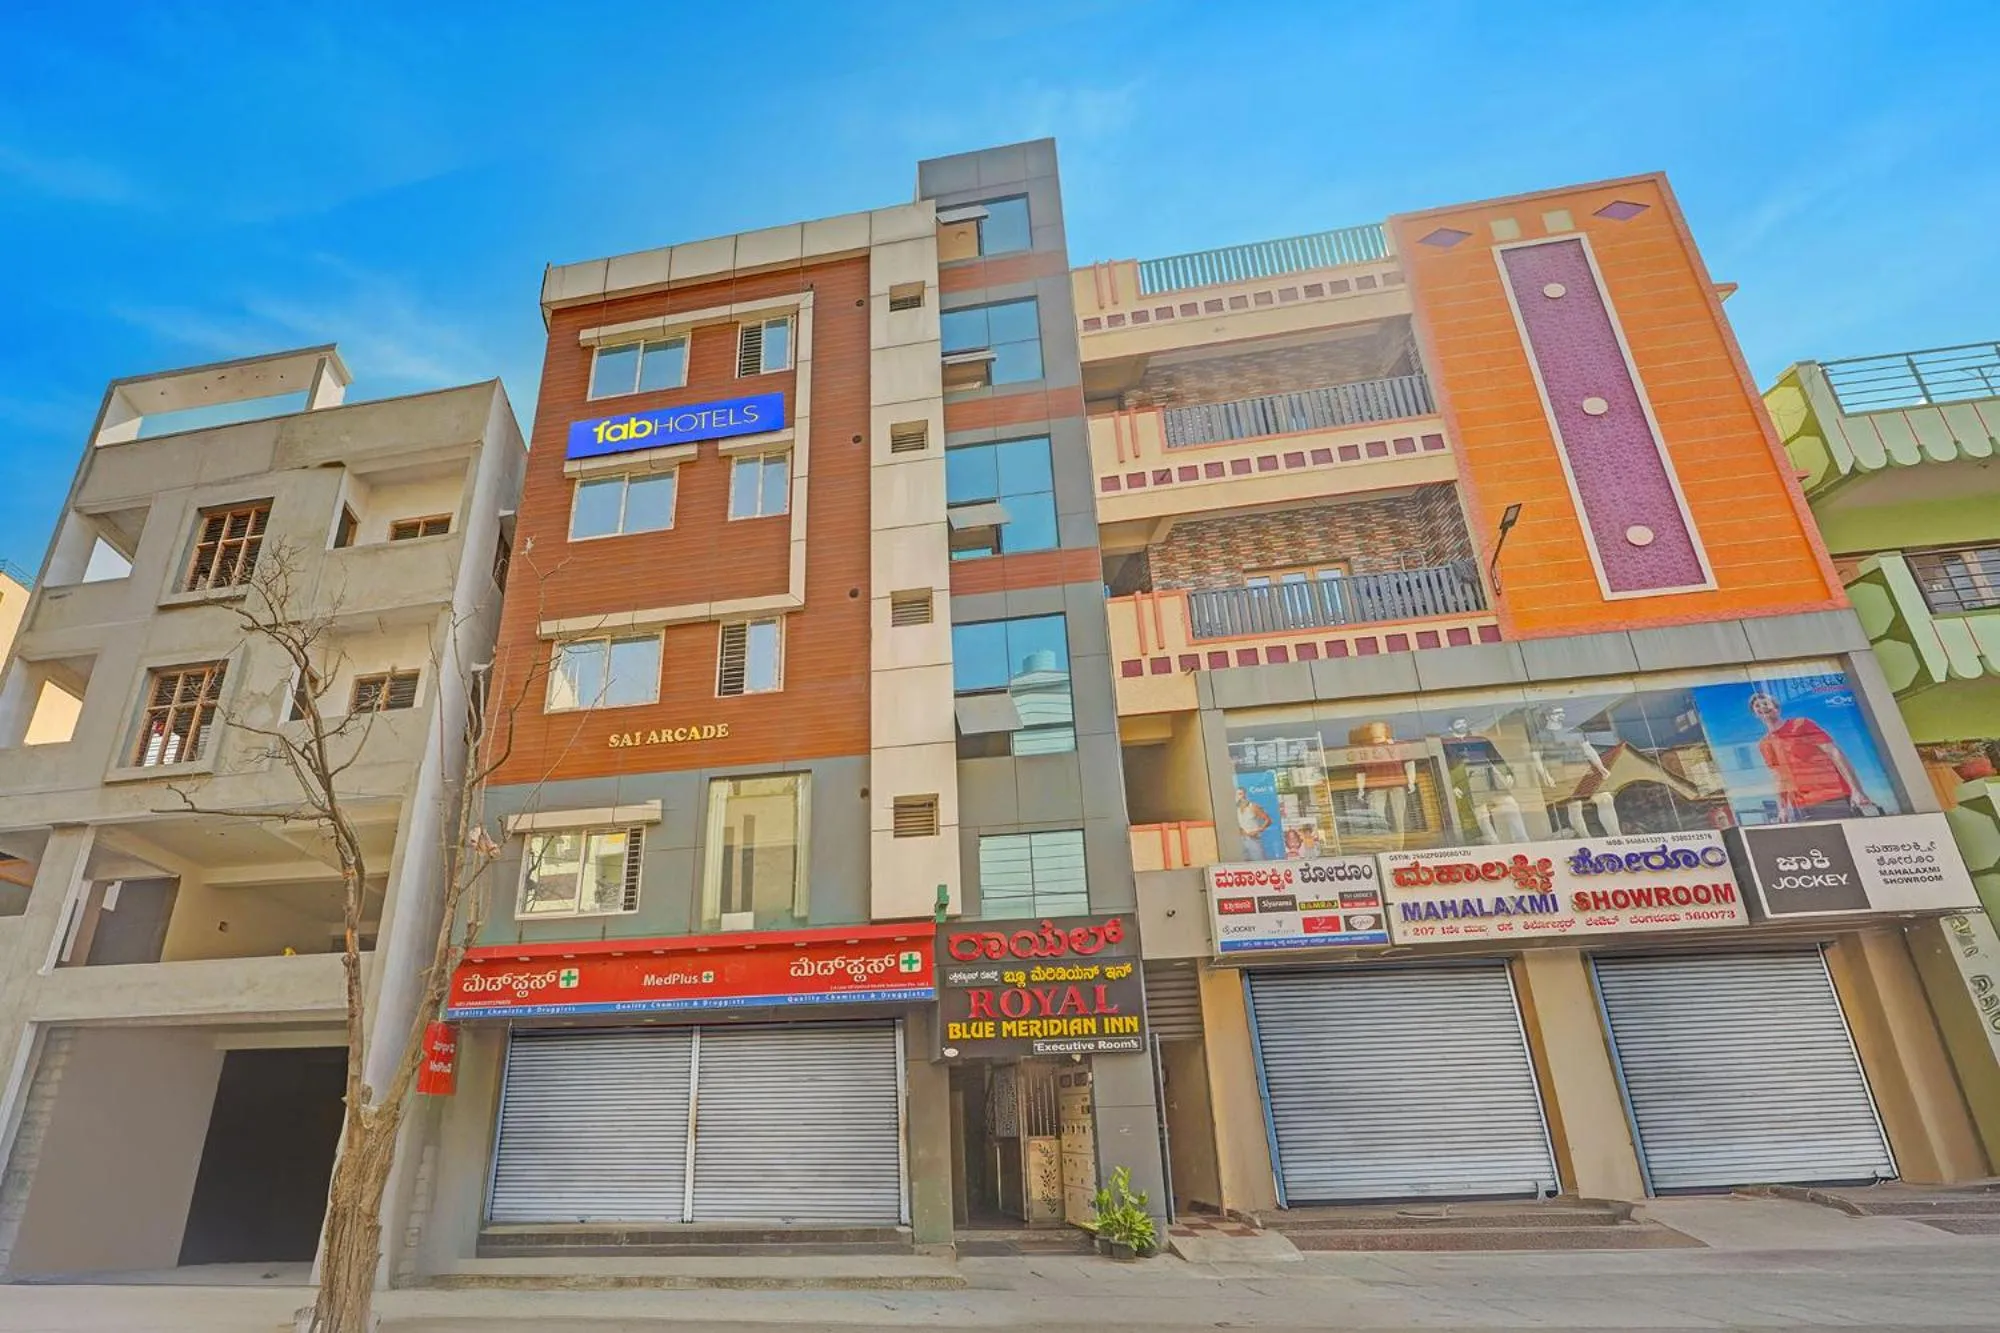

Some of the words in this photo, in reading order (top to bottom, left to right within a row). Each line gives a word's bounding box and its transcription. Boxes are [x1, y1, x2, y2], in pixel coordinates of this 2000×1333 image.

[608, 732, 642, 748] SAI
[645, 723, 729, 745] ARCADE
[1776, 848, 1831, 872] ಜಾಕಿ
[1772, 873, 1849, 890] JOCKEY
[1878, 866, 1941, 877] MAHALAXMI
[1882, 874, 1944, 885] SHOWROOM
[1401, 893, 1560, 922] MAHALAXMI
[1573, 882, 1737, 912] SHOWROOM
[1413, 926, 1436, 937] 207
[1685, 910, 1736, 921] 560073
[643, 973, 699, 986] MedPlus
[1105, 963, 1133, 980] ಇನ್
[787, 995, 821, 1003] Quality
[825, 993, 866, 1001] Chemists
[880, 991, 927, 999] Druggists
[965, 984, 1120, 1019] ROYAL
[948, 1021, 996, 1040] BLUE
[1002, 1018, 1097, 1039] MERIDIAN
[1104, 1016, 1140, 1034] INN
